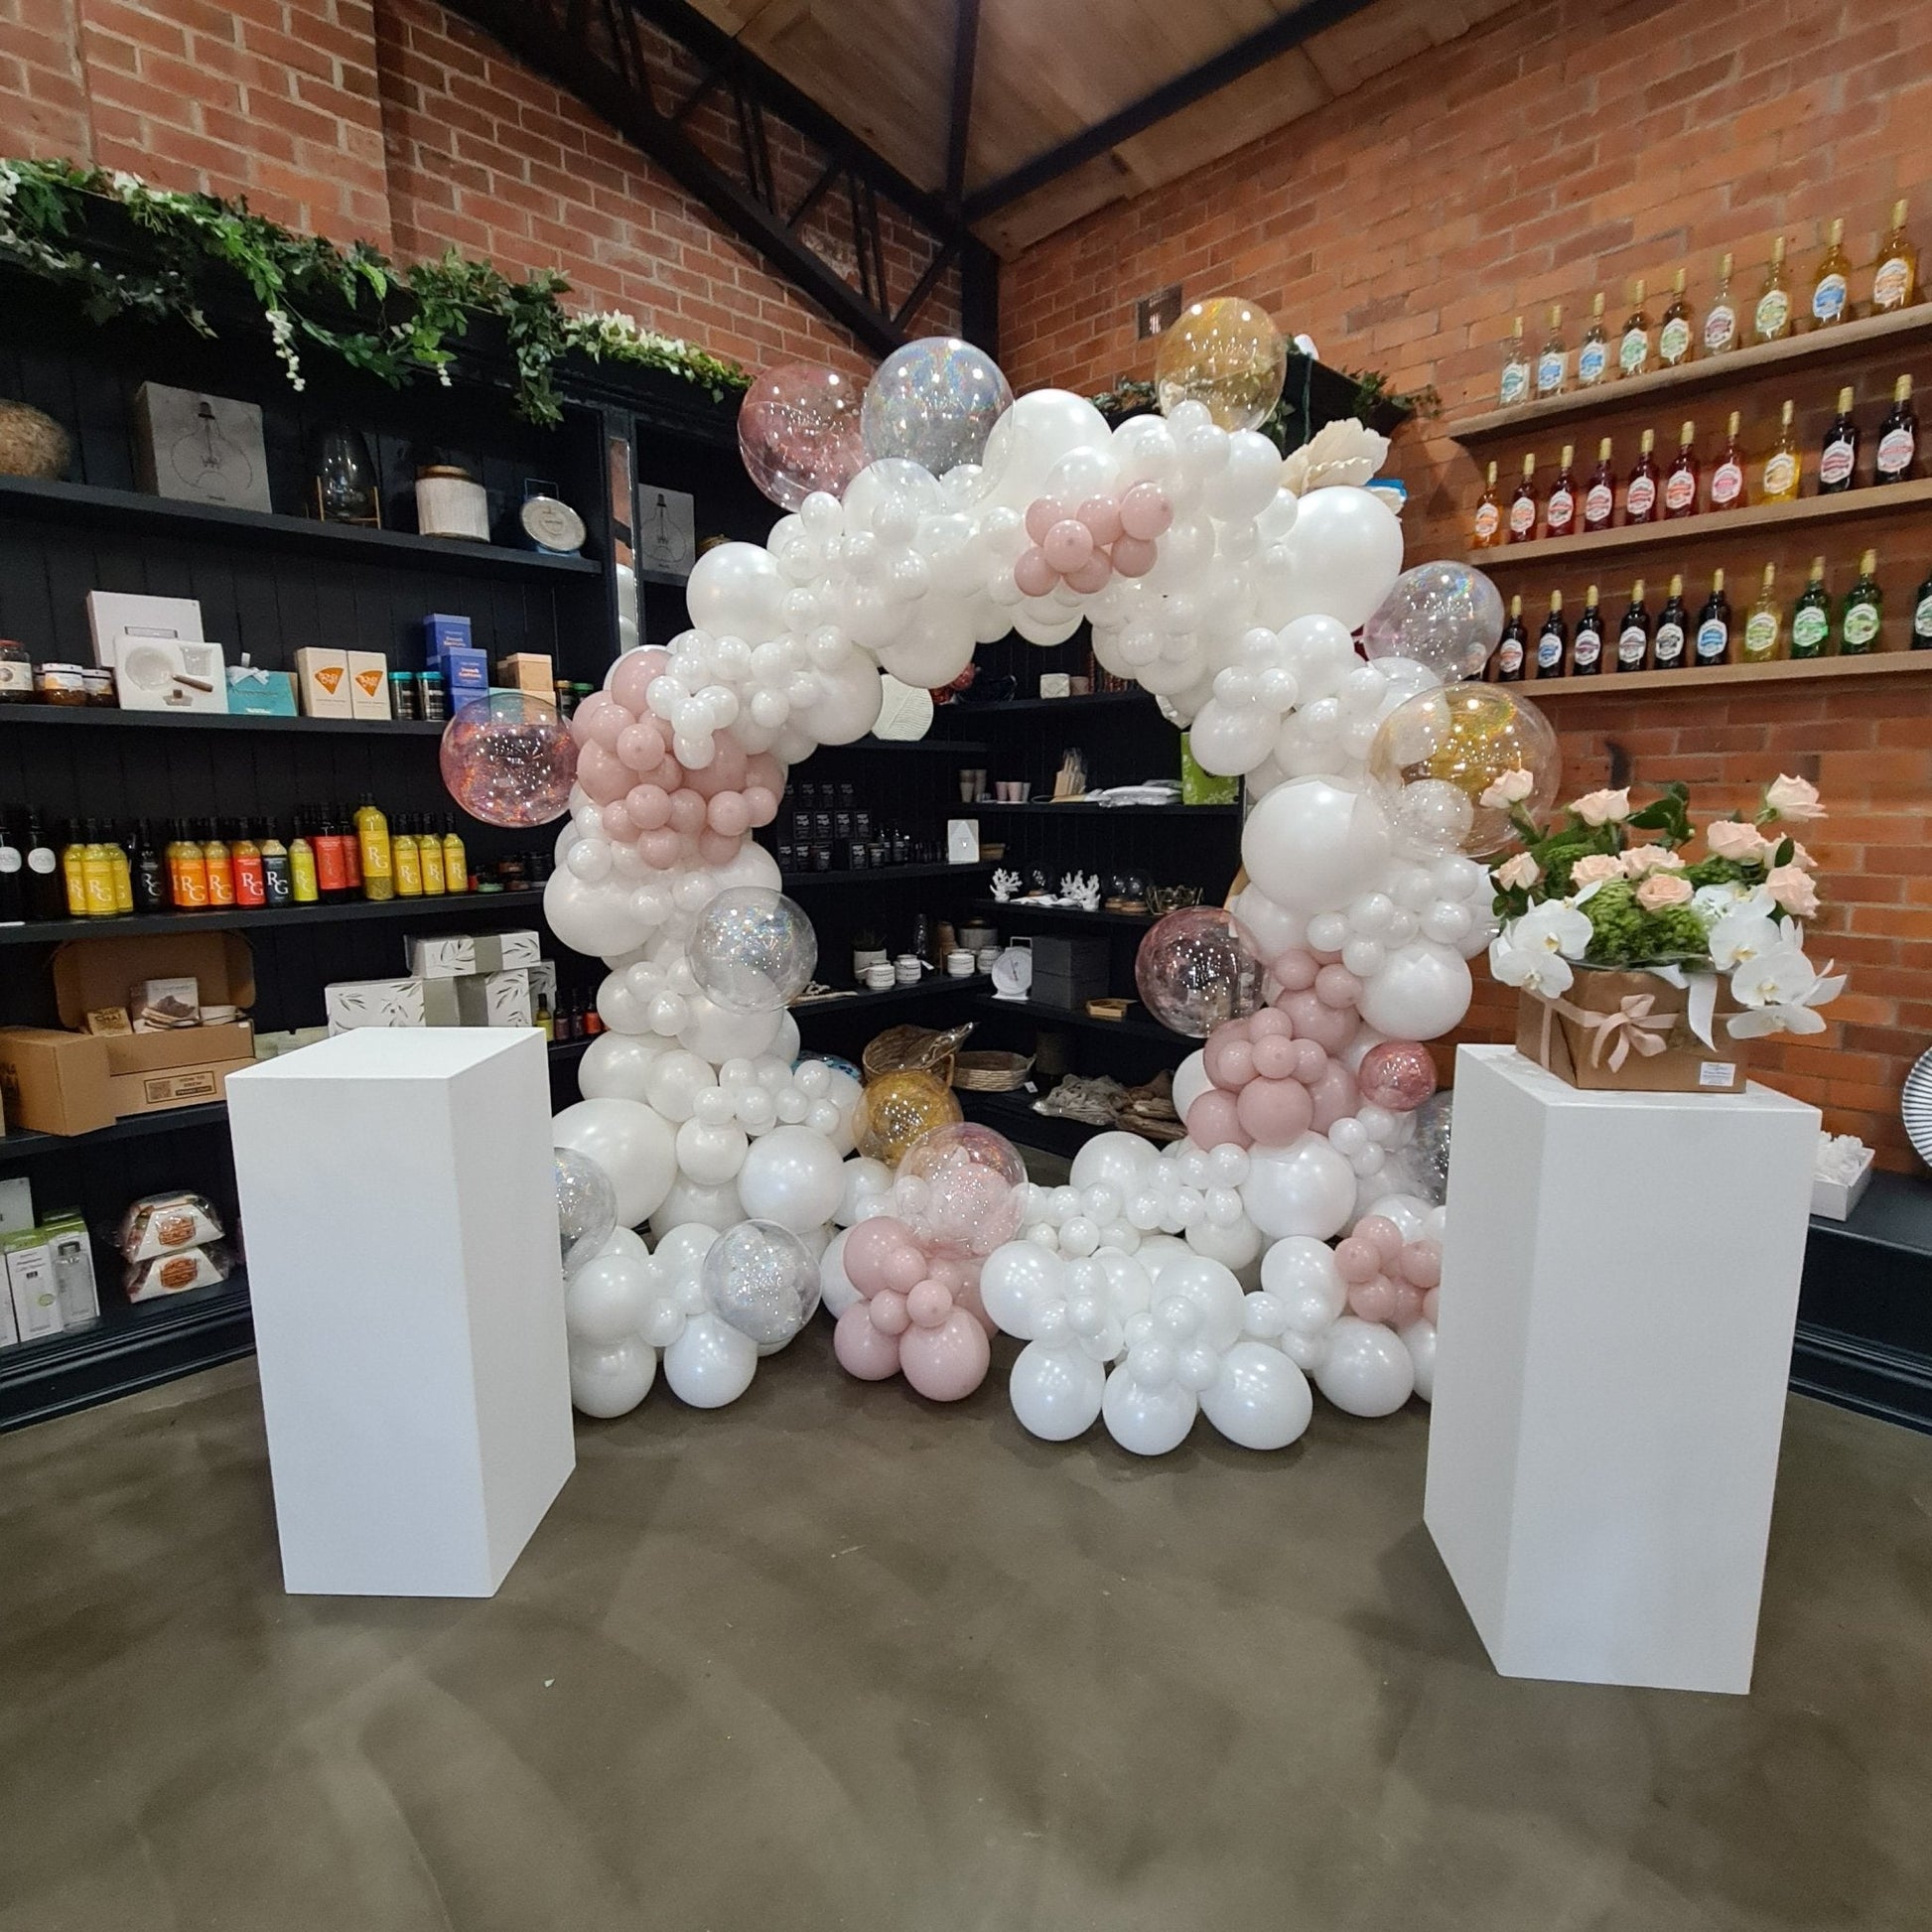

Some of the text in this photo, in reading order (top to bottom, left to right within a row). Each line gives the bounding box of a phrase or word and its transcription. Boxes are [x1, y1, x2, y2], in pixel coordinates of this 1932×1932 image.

[368, 846, 389, 870] RG
[240, 872, 264, 896] RG
[266, 871, 289, 895] RG
[400, 865, 419, 884] RG
[89, 879, 112, 901] RG
[181, 875, 206, 901] RG
[208, 874, 232, 900] RG
